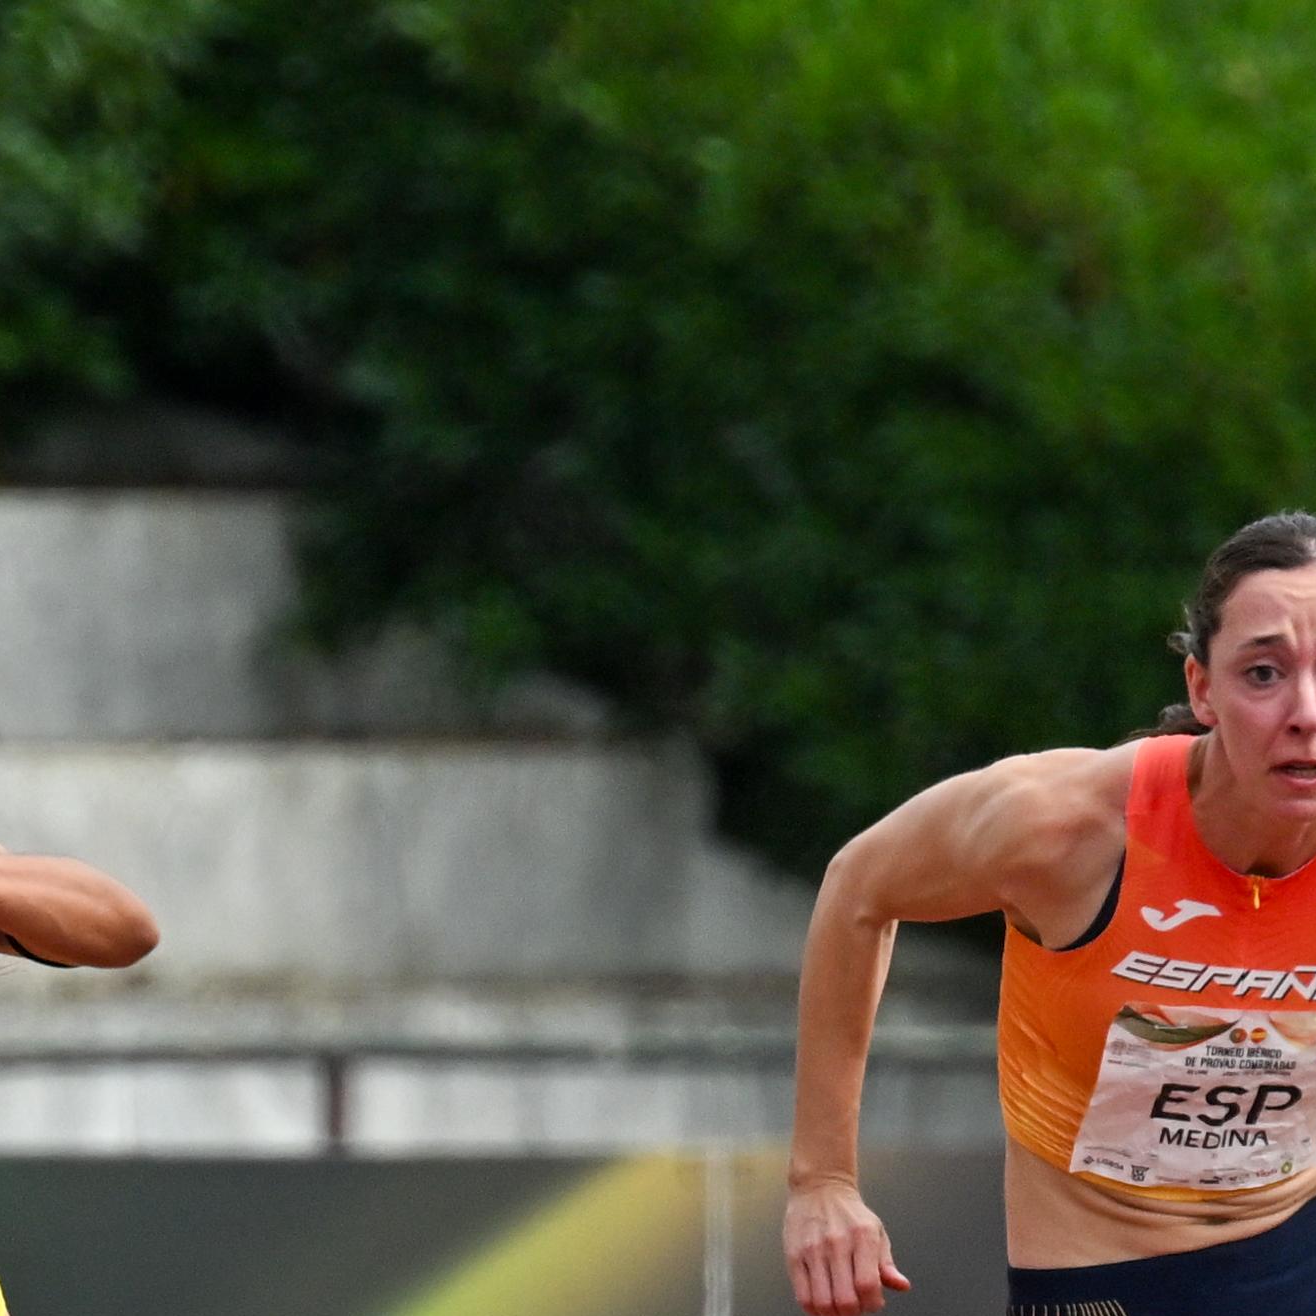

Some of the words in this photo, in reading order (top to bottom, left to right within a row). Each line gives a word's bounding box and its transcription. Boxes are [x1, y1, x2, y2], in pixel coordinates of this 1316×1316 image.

[1206, 1045, 1244, 1058] TORNEIO
[1185, 1056, 1197, 1067] DE
[1201, 1057, 1236, 1069] PROVAS
[1150, 1083, 1303, 1127] ESP
[1159, 1127, 1270, 1149] MEDINA
